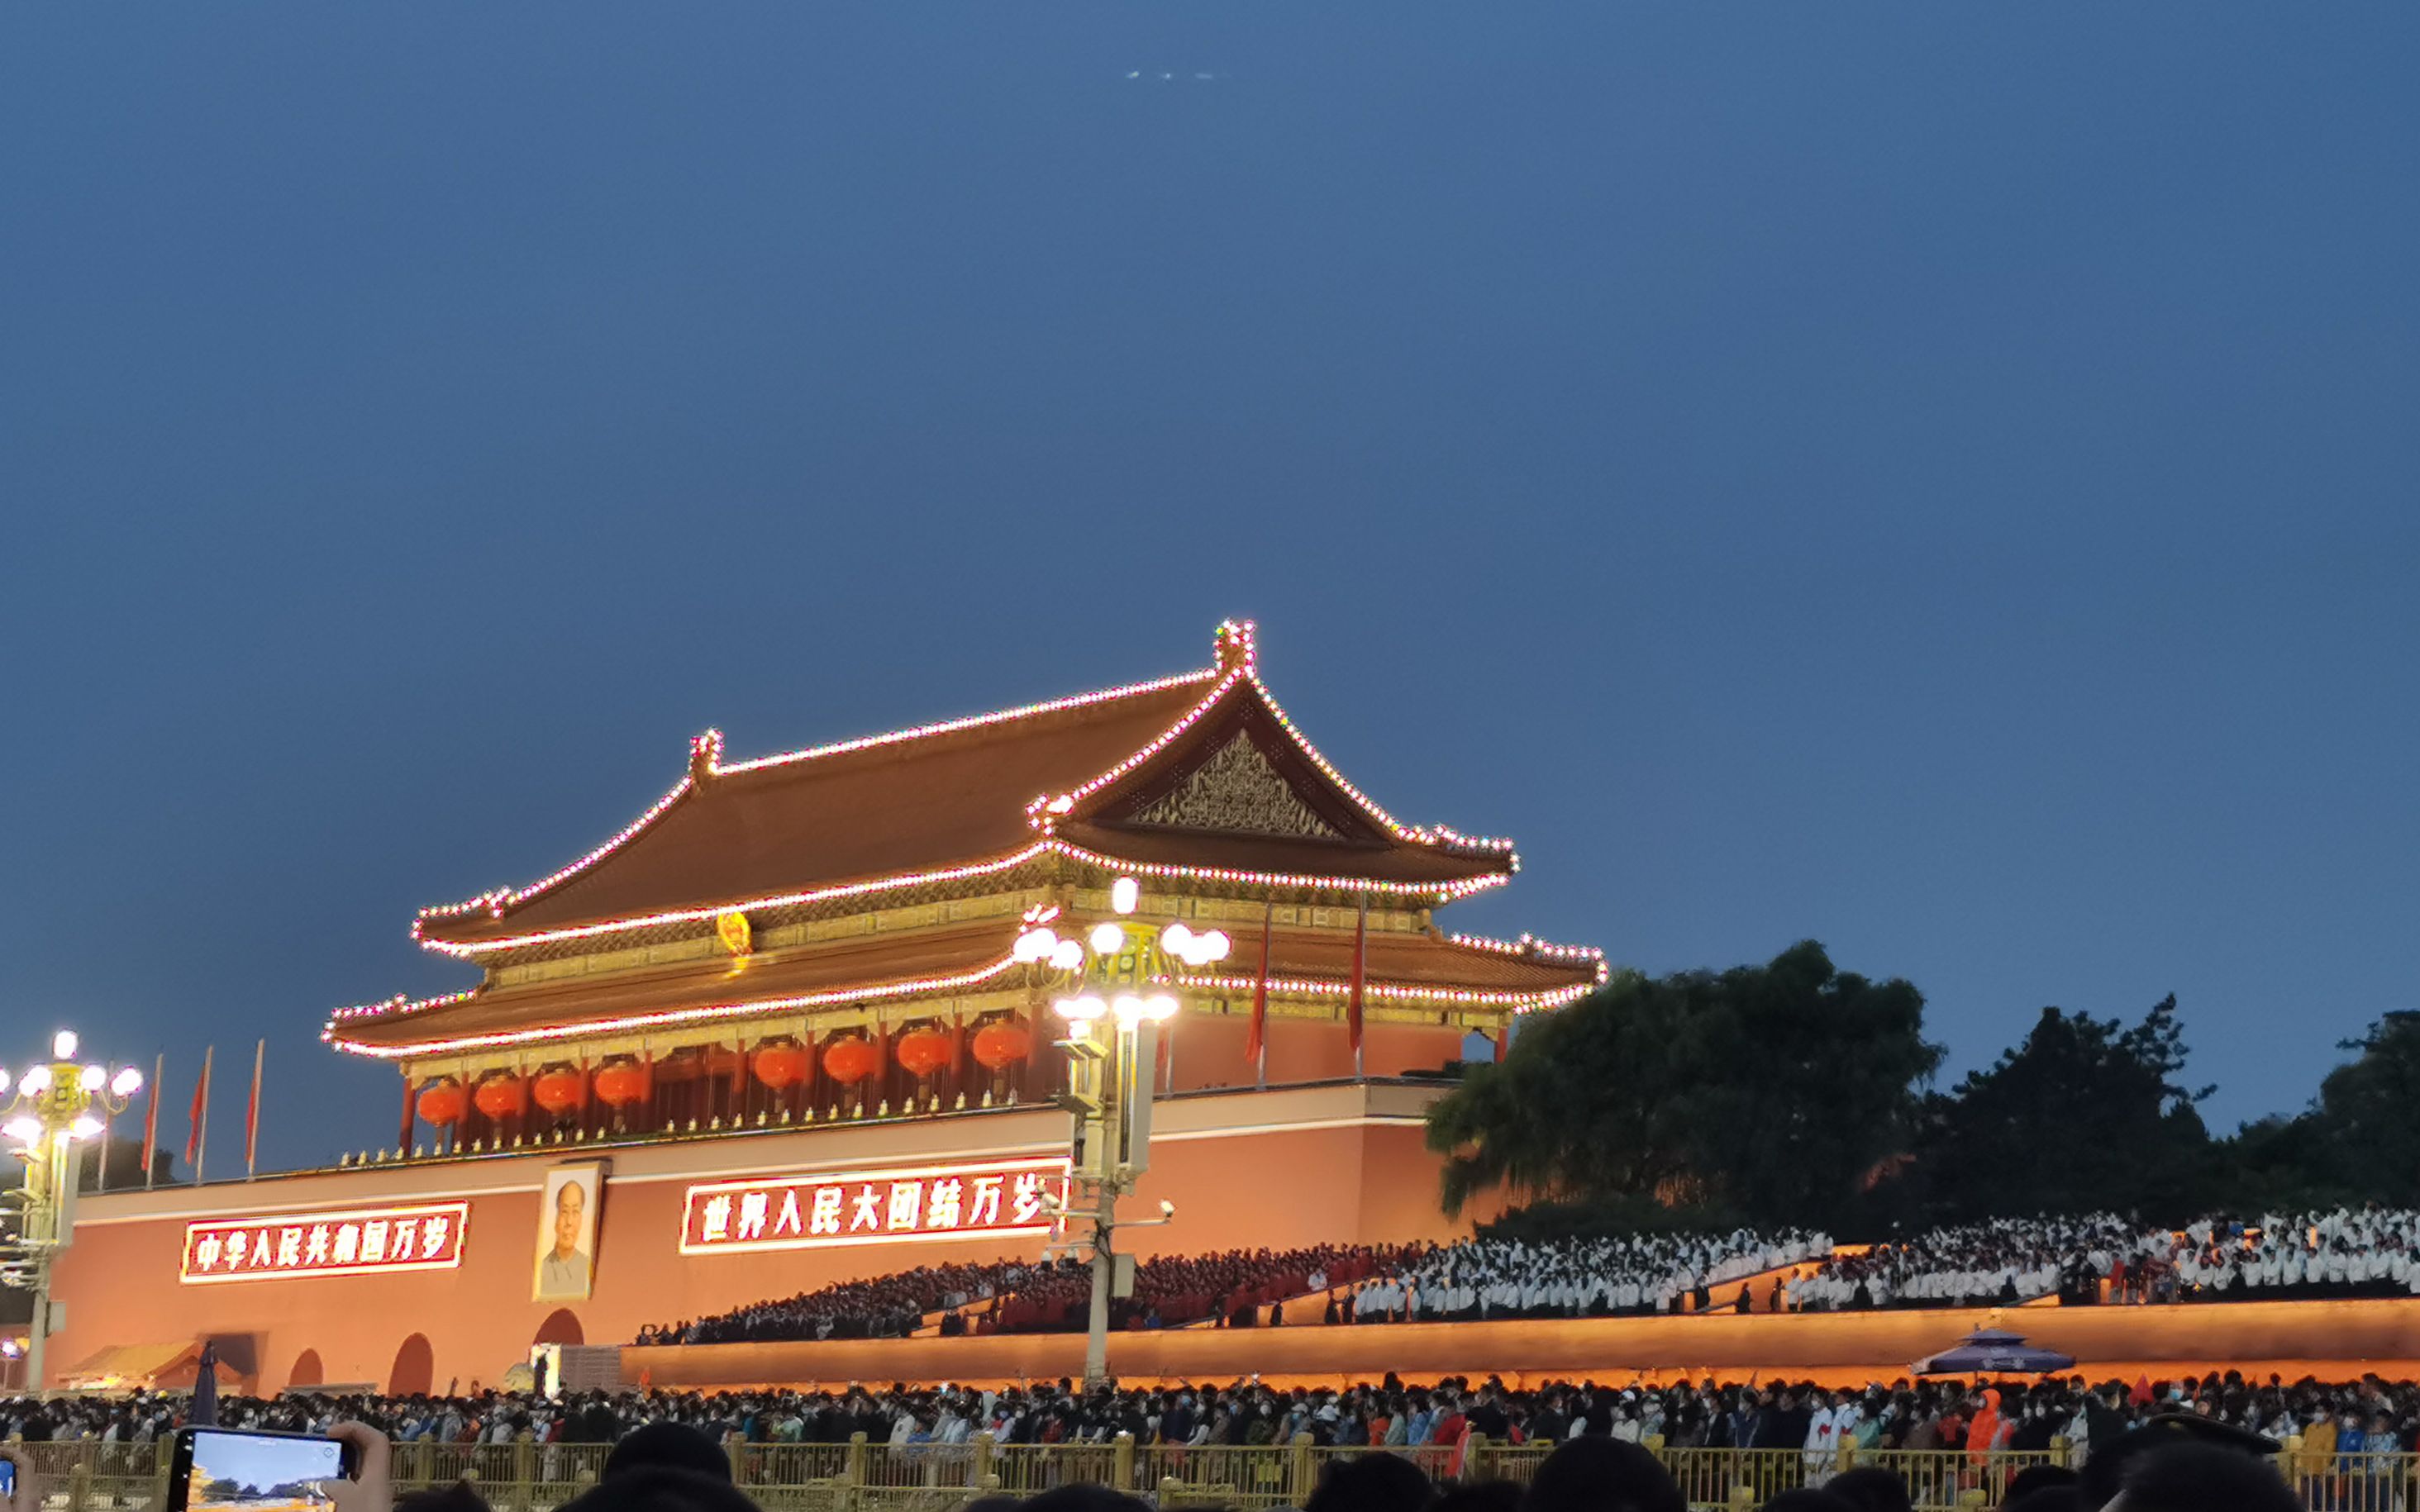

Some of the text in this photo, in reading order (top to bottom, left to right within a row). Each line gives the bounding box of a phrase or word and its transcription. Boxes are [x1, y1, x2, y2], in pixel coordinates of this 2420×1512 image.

[703, 1172, 1045, 1241] 世界人民大团结万岁
[197, 1217, 448, 1271] 中华人民共和国万岁
